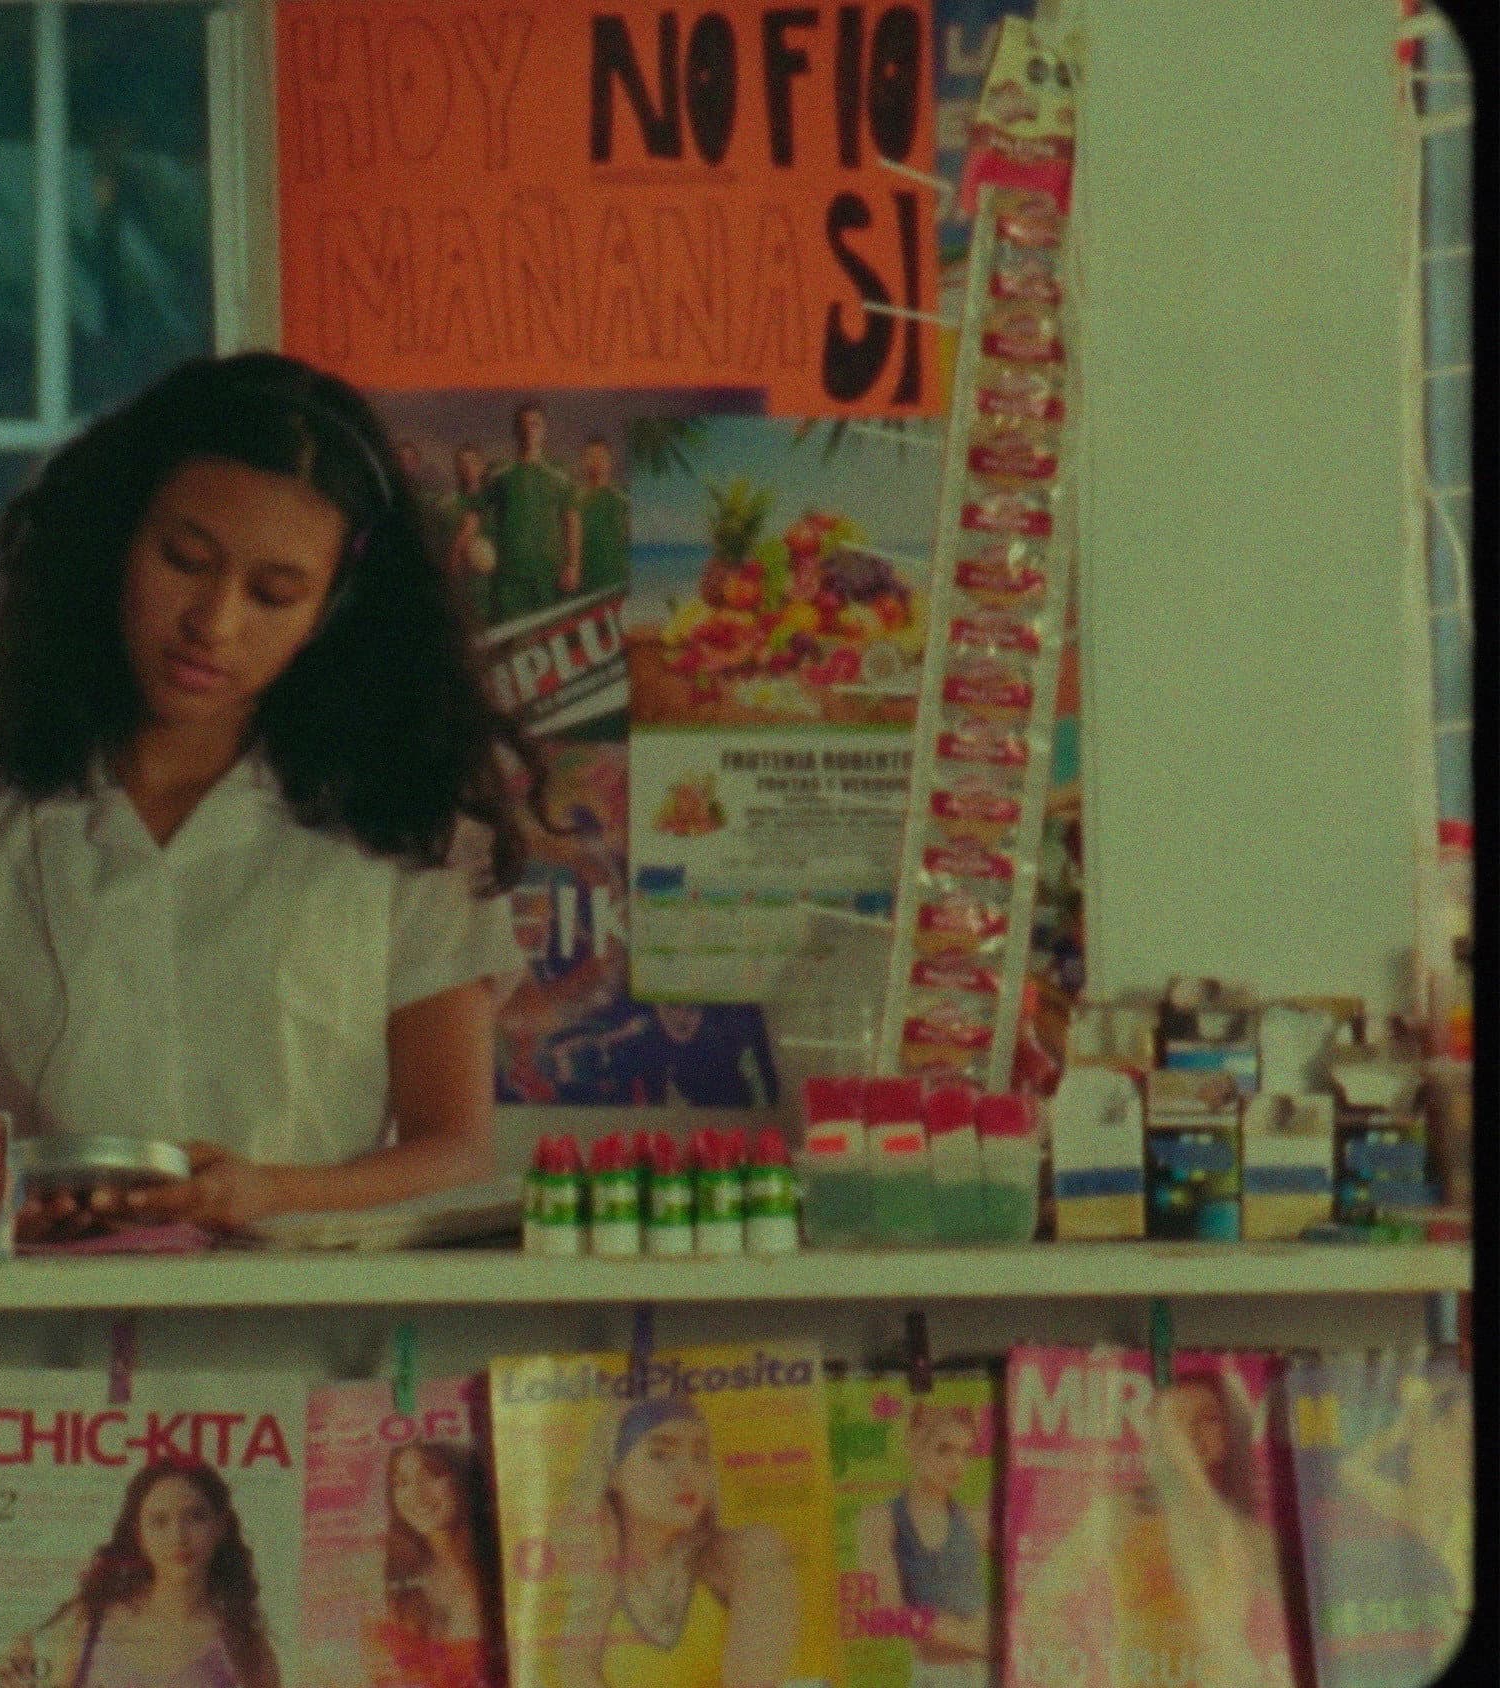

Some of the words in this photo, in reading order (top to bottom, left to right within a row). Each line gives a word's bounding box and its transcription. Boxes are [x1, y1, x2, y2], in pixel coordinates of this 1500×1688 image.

[290, 9, 537, 180] HOY
[588, 11, 739, 165] NO
[762, 6, 922, 168] FIO
[315, 185, 808, 371] MAÑANA
[821, 190, 923, 405] SI
